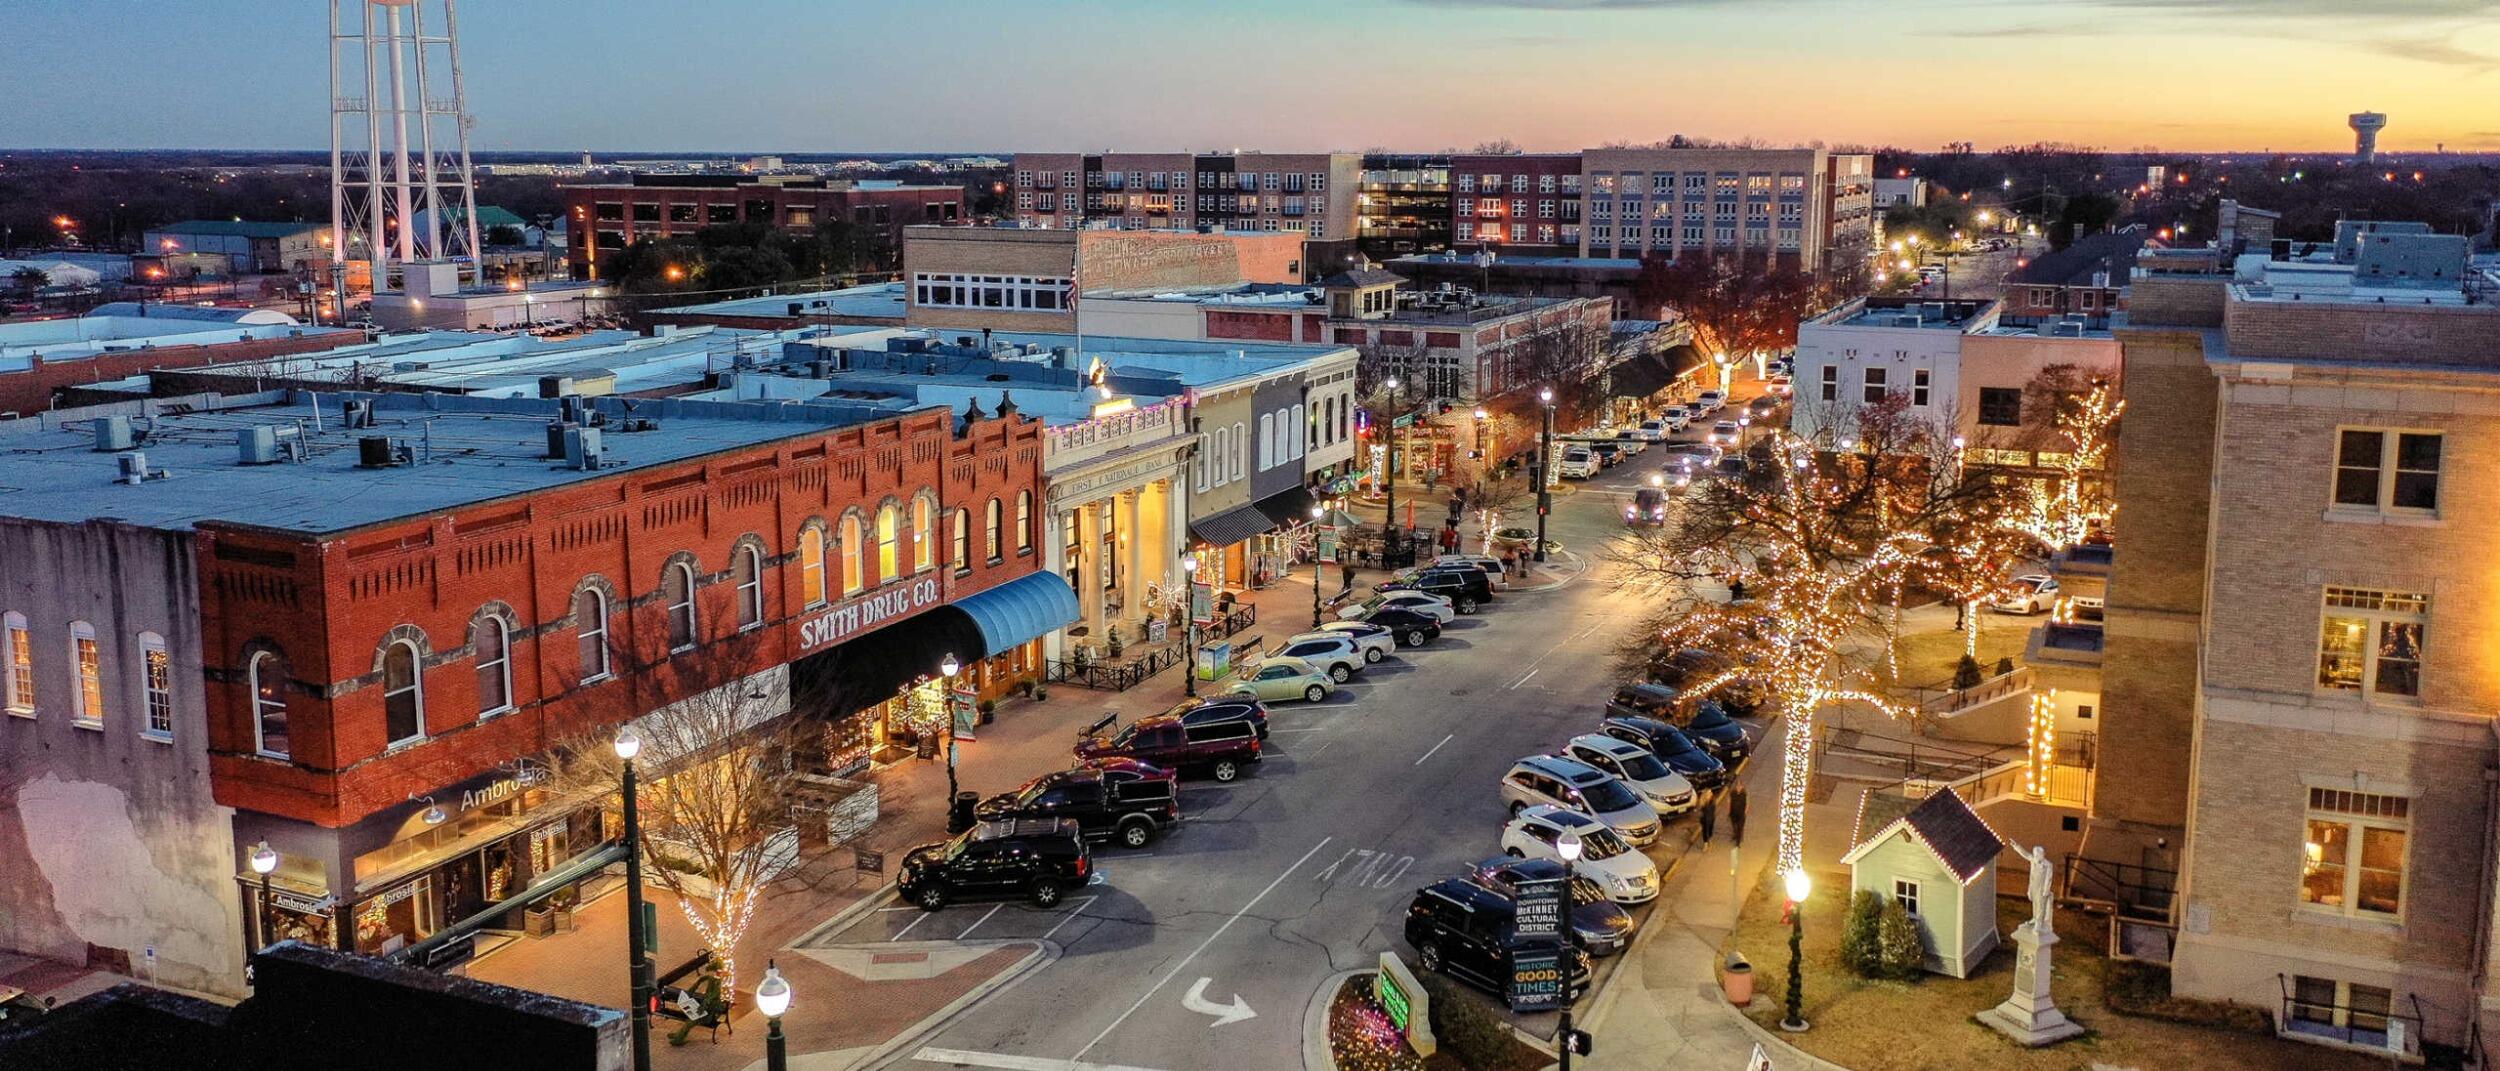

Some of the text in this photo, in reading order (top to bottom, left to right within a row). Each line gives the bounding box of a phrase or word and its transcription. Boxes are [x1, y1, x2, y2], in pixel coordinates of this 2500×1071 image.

[800, 578, 938, 650] SMITH DRUG CO.
[460, 765, 546, 812] Ambrosia
[276, 894, 318, 914] Ambrosia
[1516, 898, 1558, 906] DOWNTOWN
[1516, 905, 1558, 915] McKINNEY
[1516, 914, 1558, 923] CULTURAL
[1519, 923, 1555, 932] DISTRICT
[1516, 962, 1557, 971] HISTORIC
[1515, 970, 1557, 982] GOOD
[1515, 981, 1557, 994] TIMES
